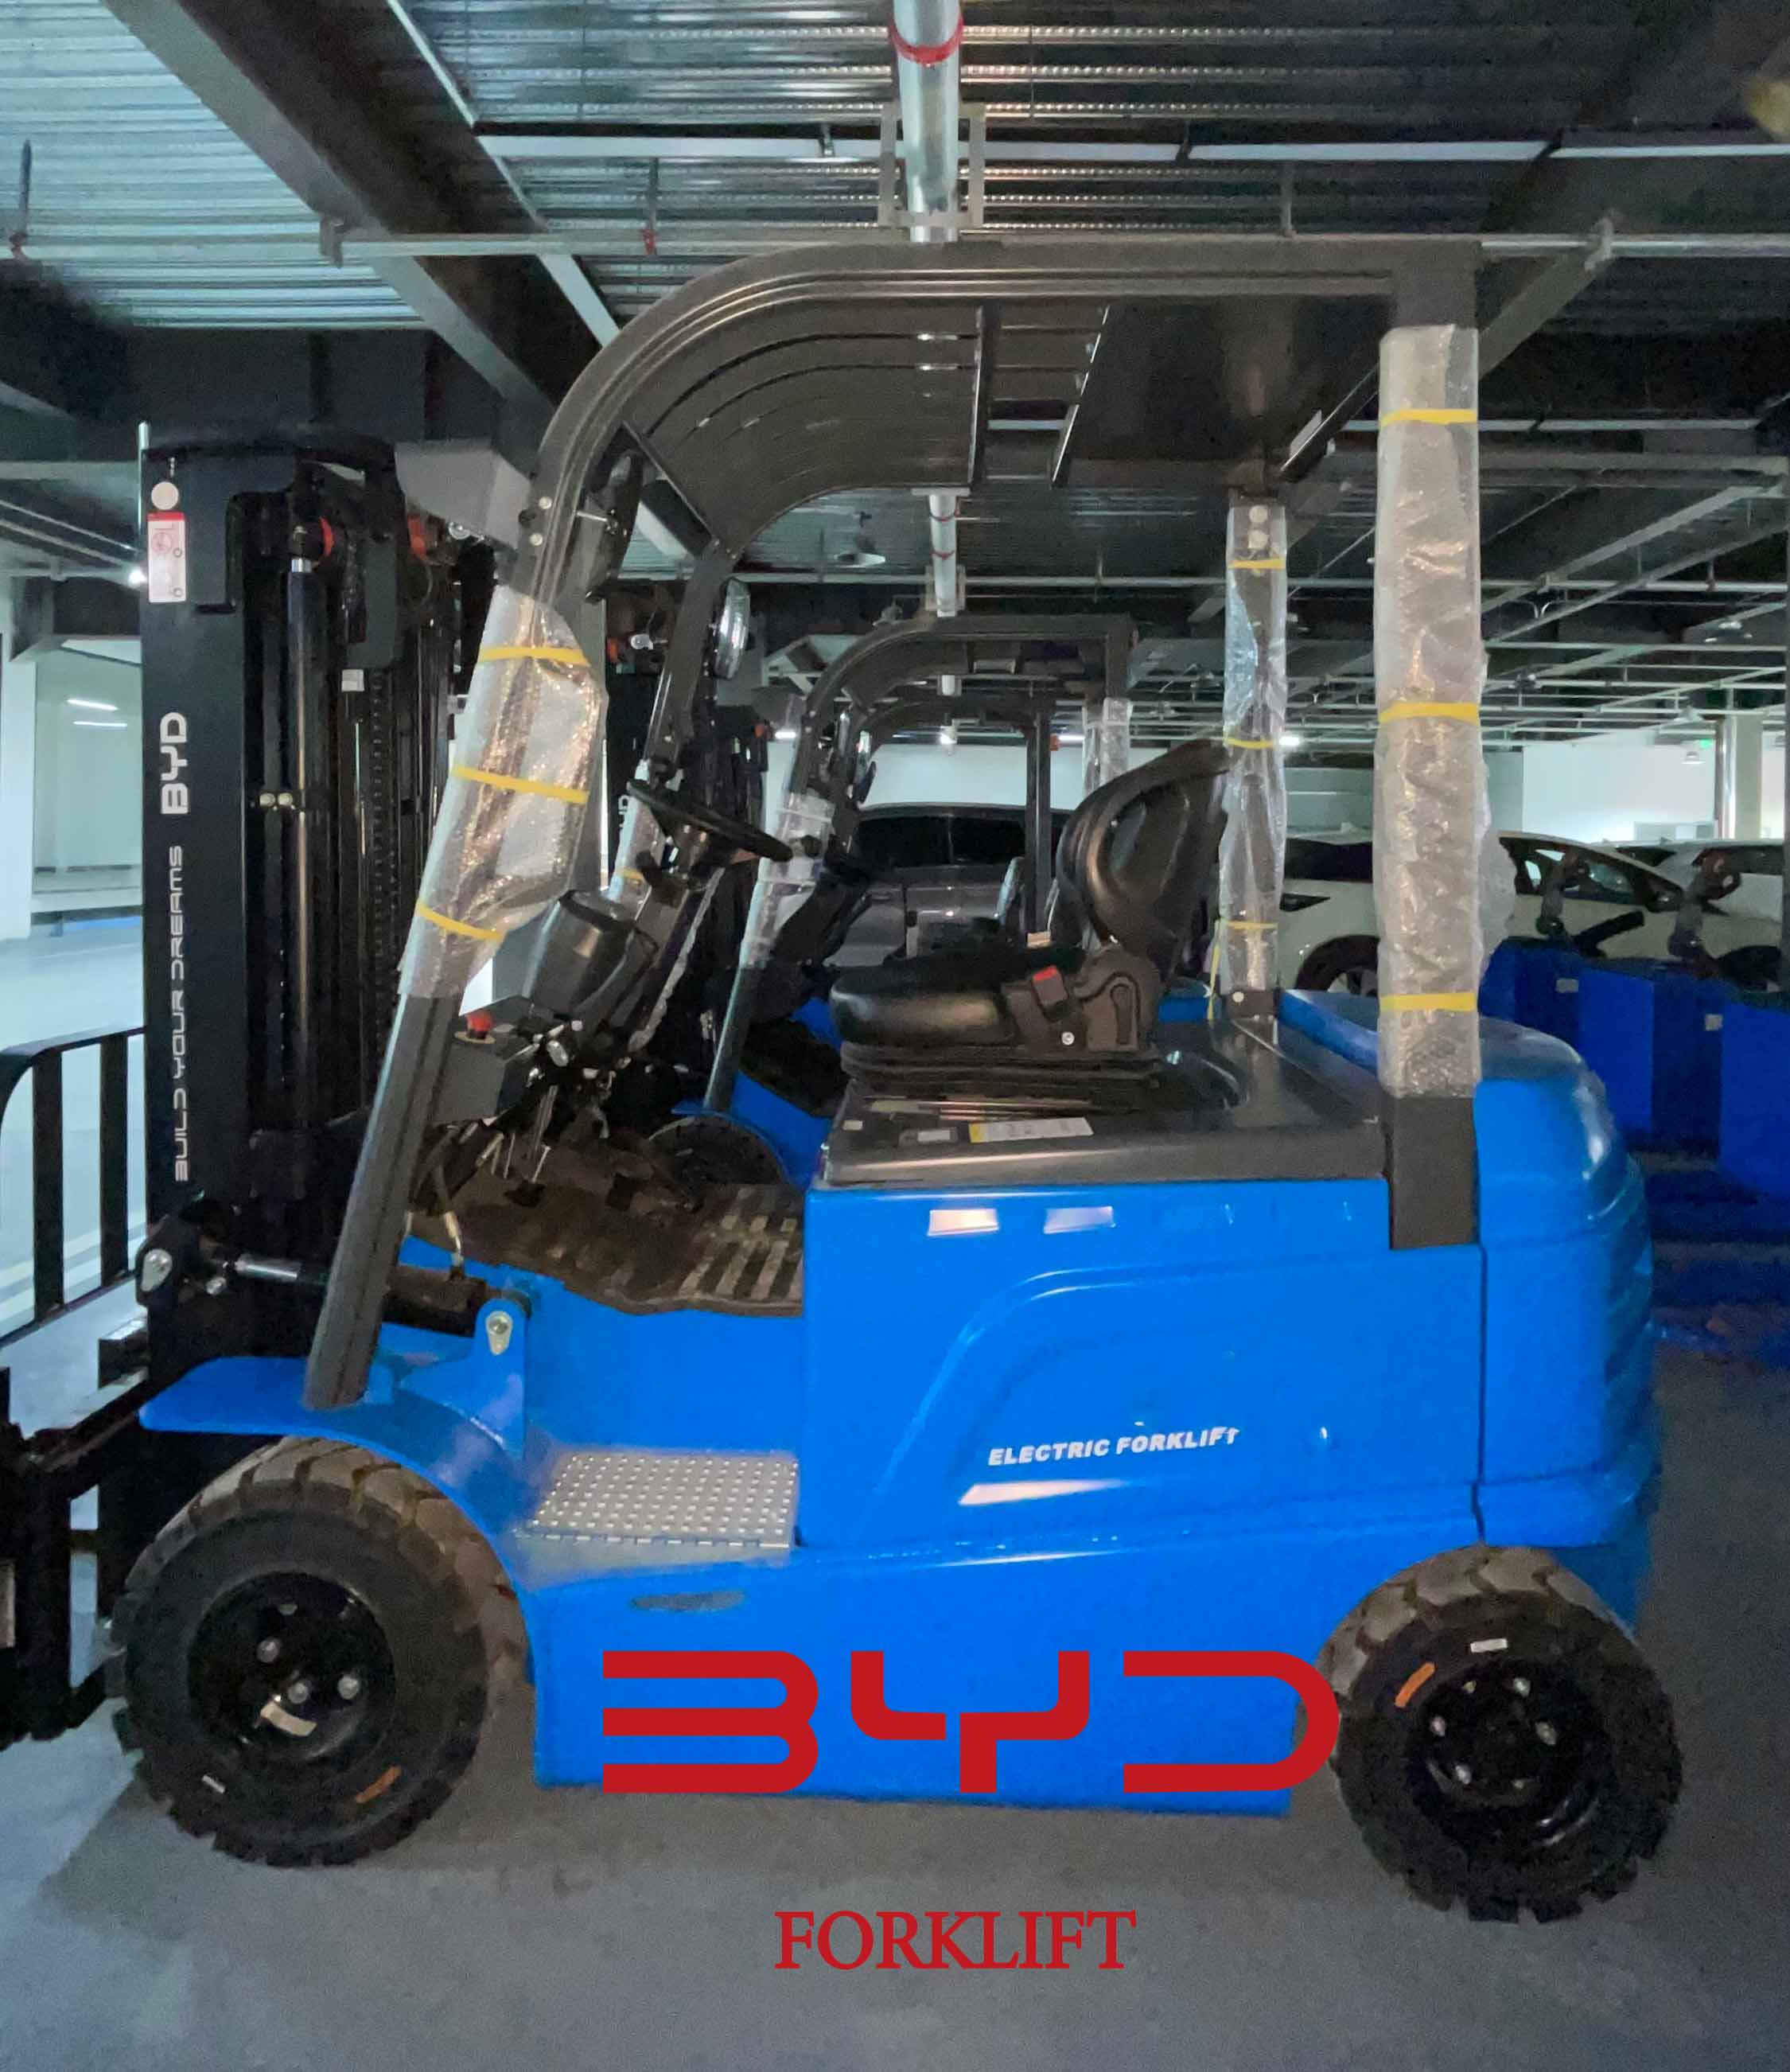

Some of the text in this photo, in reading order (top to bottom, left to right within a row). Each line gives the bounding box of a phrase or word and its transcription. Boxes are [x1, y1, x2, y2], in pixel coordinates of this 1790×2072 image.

[160, 712, 189, 815] BYD
[169, 846, 189, 1182] BUILD YOUR DREAMS
[988, 1427, 1239, 1466] ELECTRIC FORKLIFT
